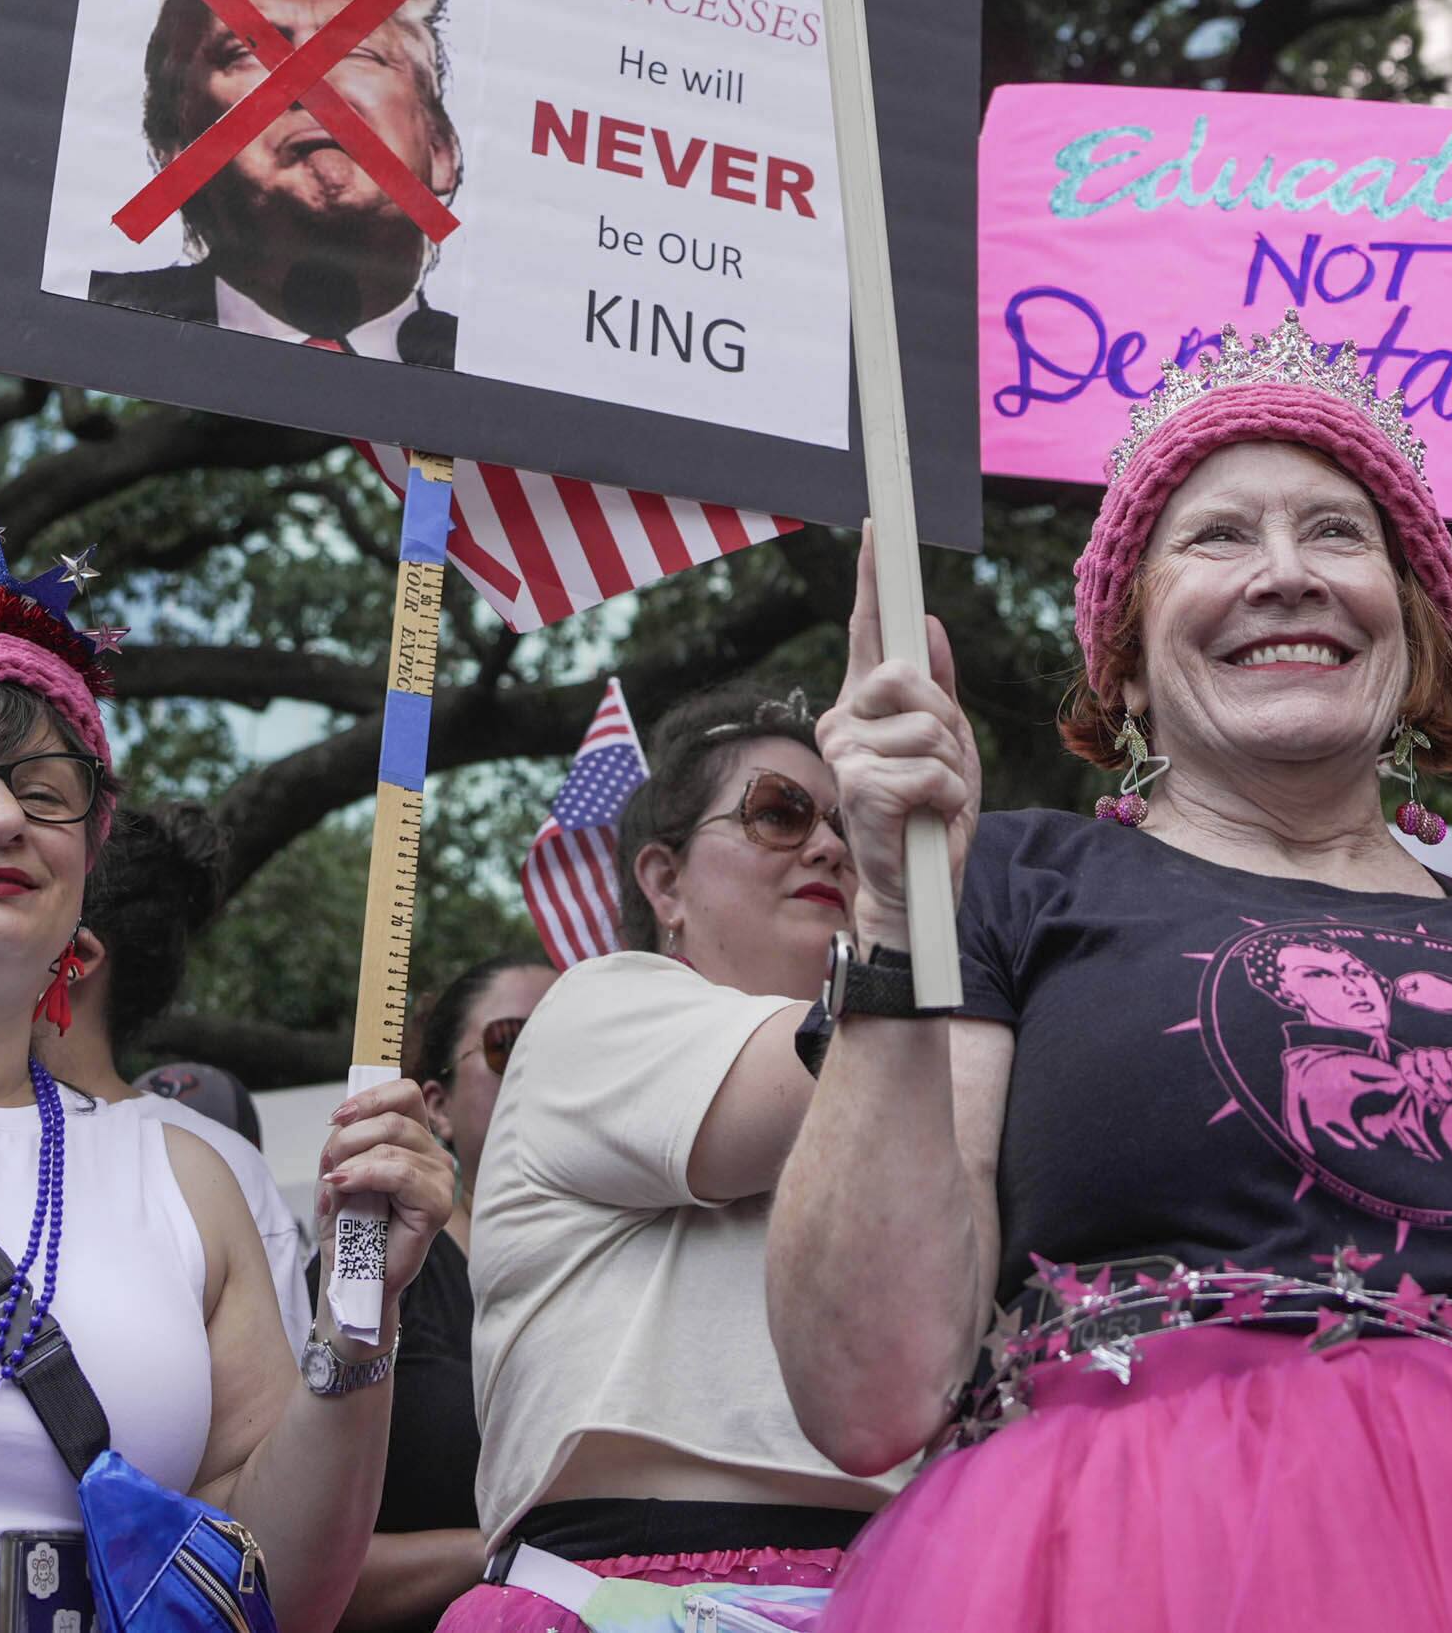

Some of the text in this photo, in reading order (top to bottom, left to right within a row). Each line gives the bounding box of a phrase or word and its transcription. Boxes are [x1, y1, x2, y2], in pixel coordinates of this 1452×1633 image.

[619, 45, 744, 105] He will
[531, 99, 817, 220] NEVER
[598, 215, 743, 279] be OUR
[585, 289, 746, 373] KING
